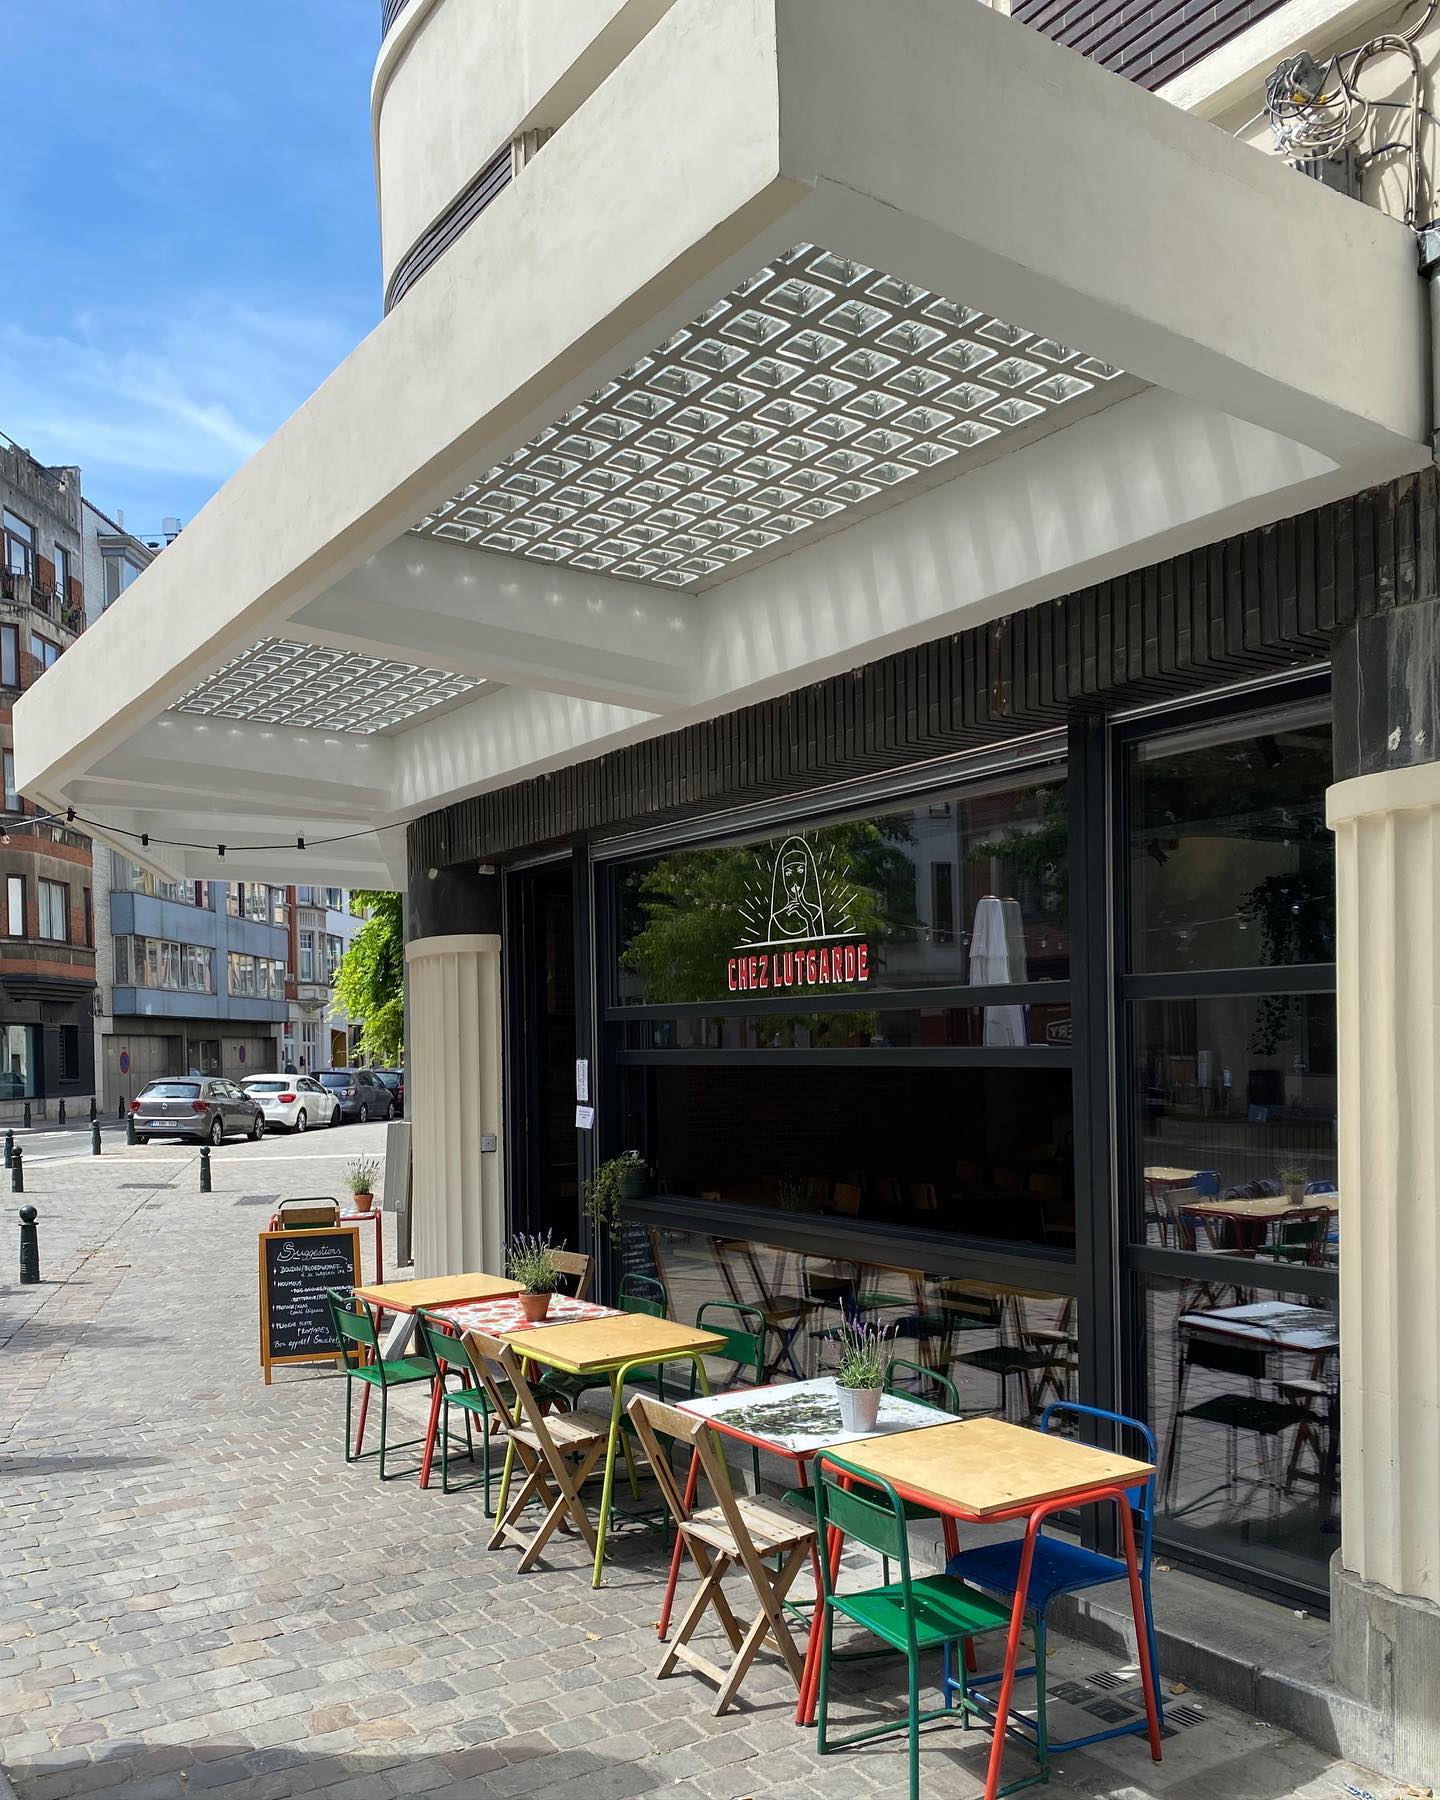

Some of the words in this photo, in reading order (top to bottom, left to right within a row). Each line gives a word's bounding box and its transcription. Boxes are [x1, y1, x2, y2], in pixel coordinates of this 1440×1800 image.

[728, 955, 769, 991] CHEZ
[773, 943, 870, 988] LUTGARDE
[277, 1241, 341, 1261] Suggestions
